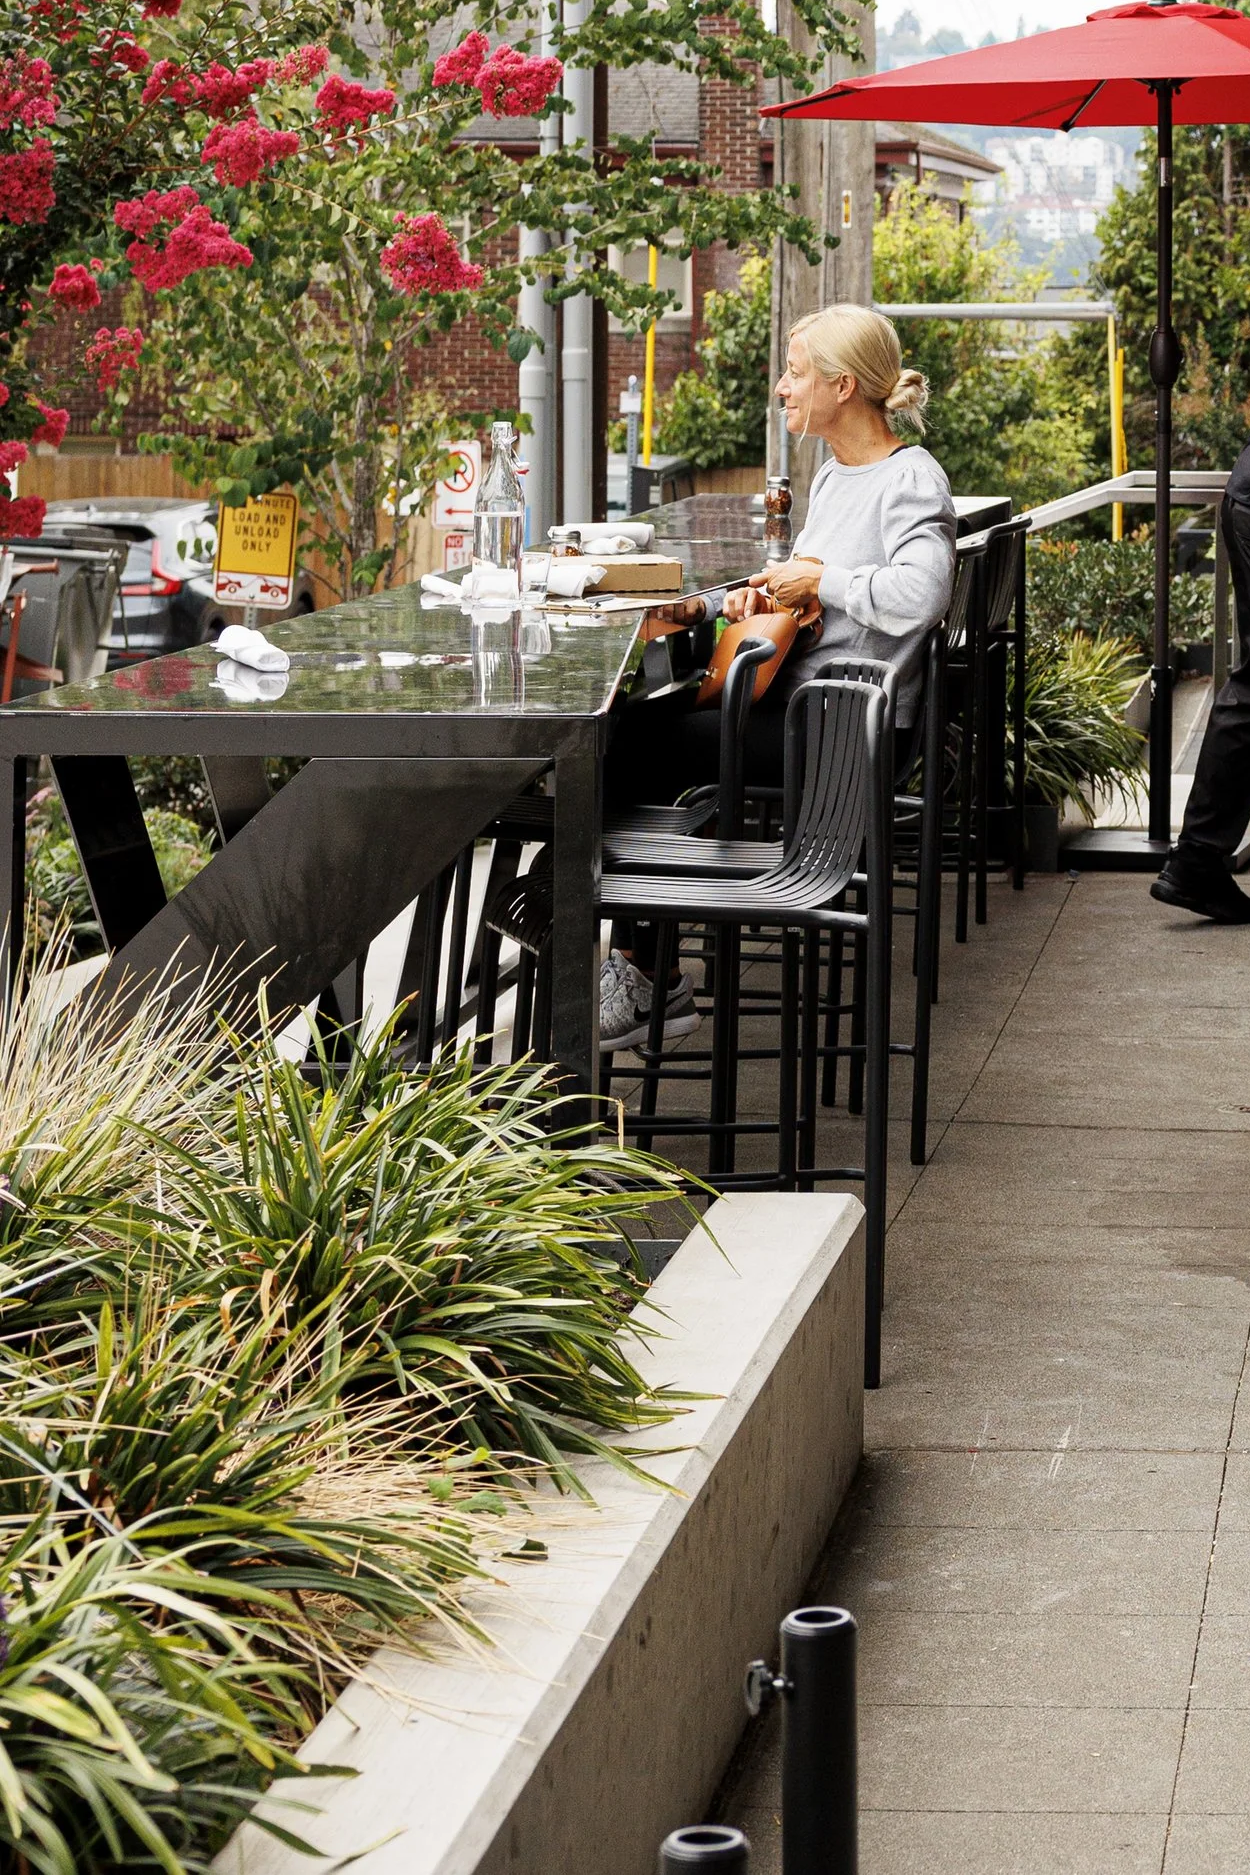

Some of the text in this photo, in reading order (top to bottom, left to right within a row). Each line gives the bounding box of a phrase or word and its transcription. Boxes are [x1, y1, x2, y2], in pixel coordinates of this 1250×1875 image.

[232, 511, 286, 525] LOAD AND
[235, 526, 279, 538] UNLOAD
[242, 540, 271, 551] ONLY
[447, 535, 463, 548] NO
